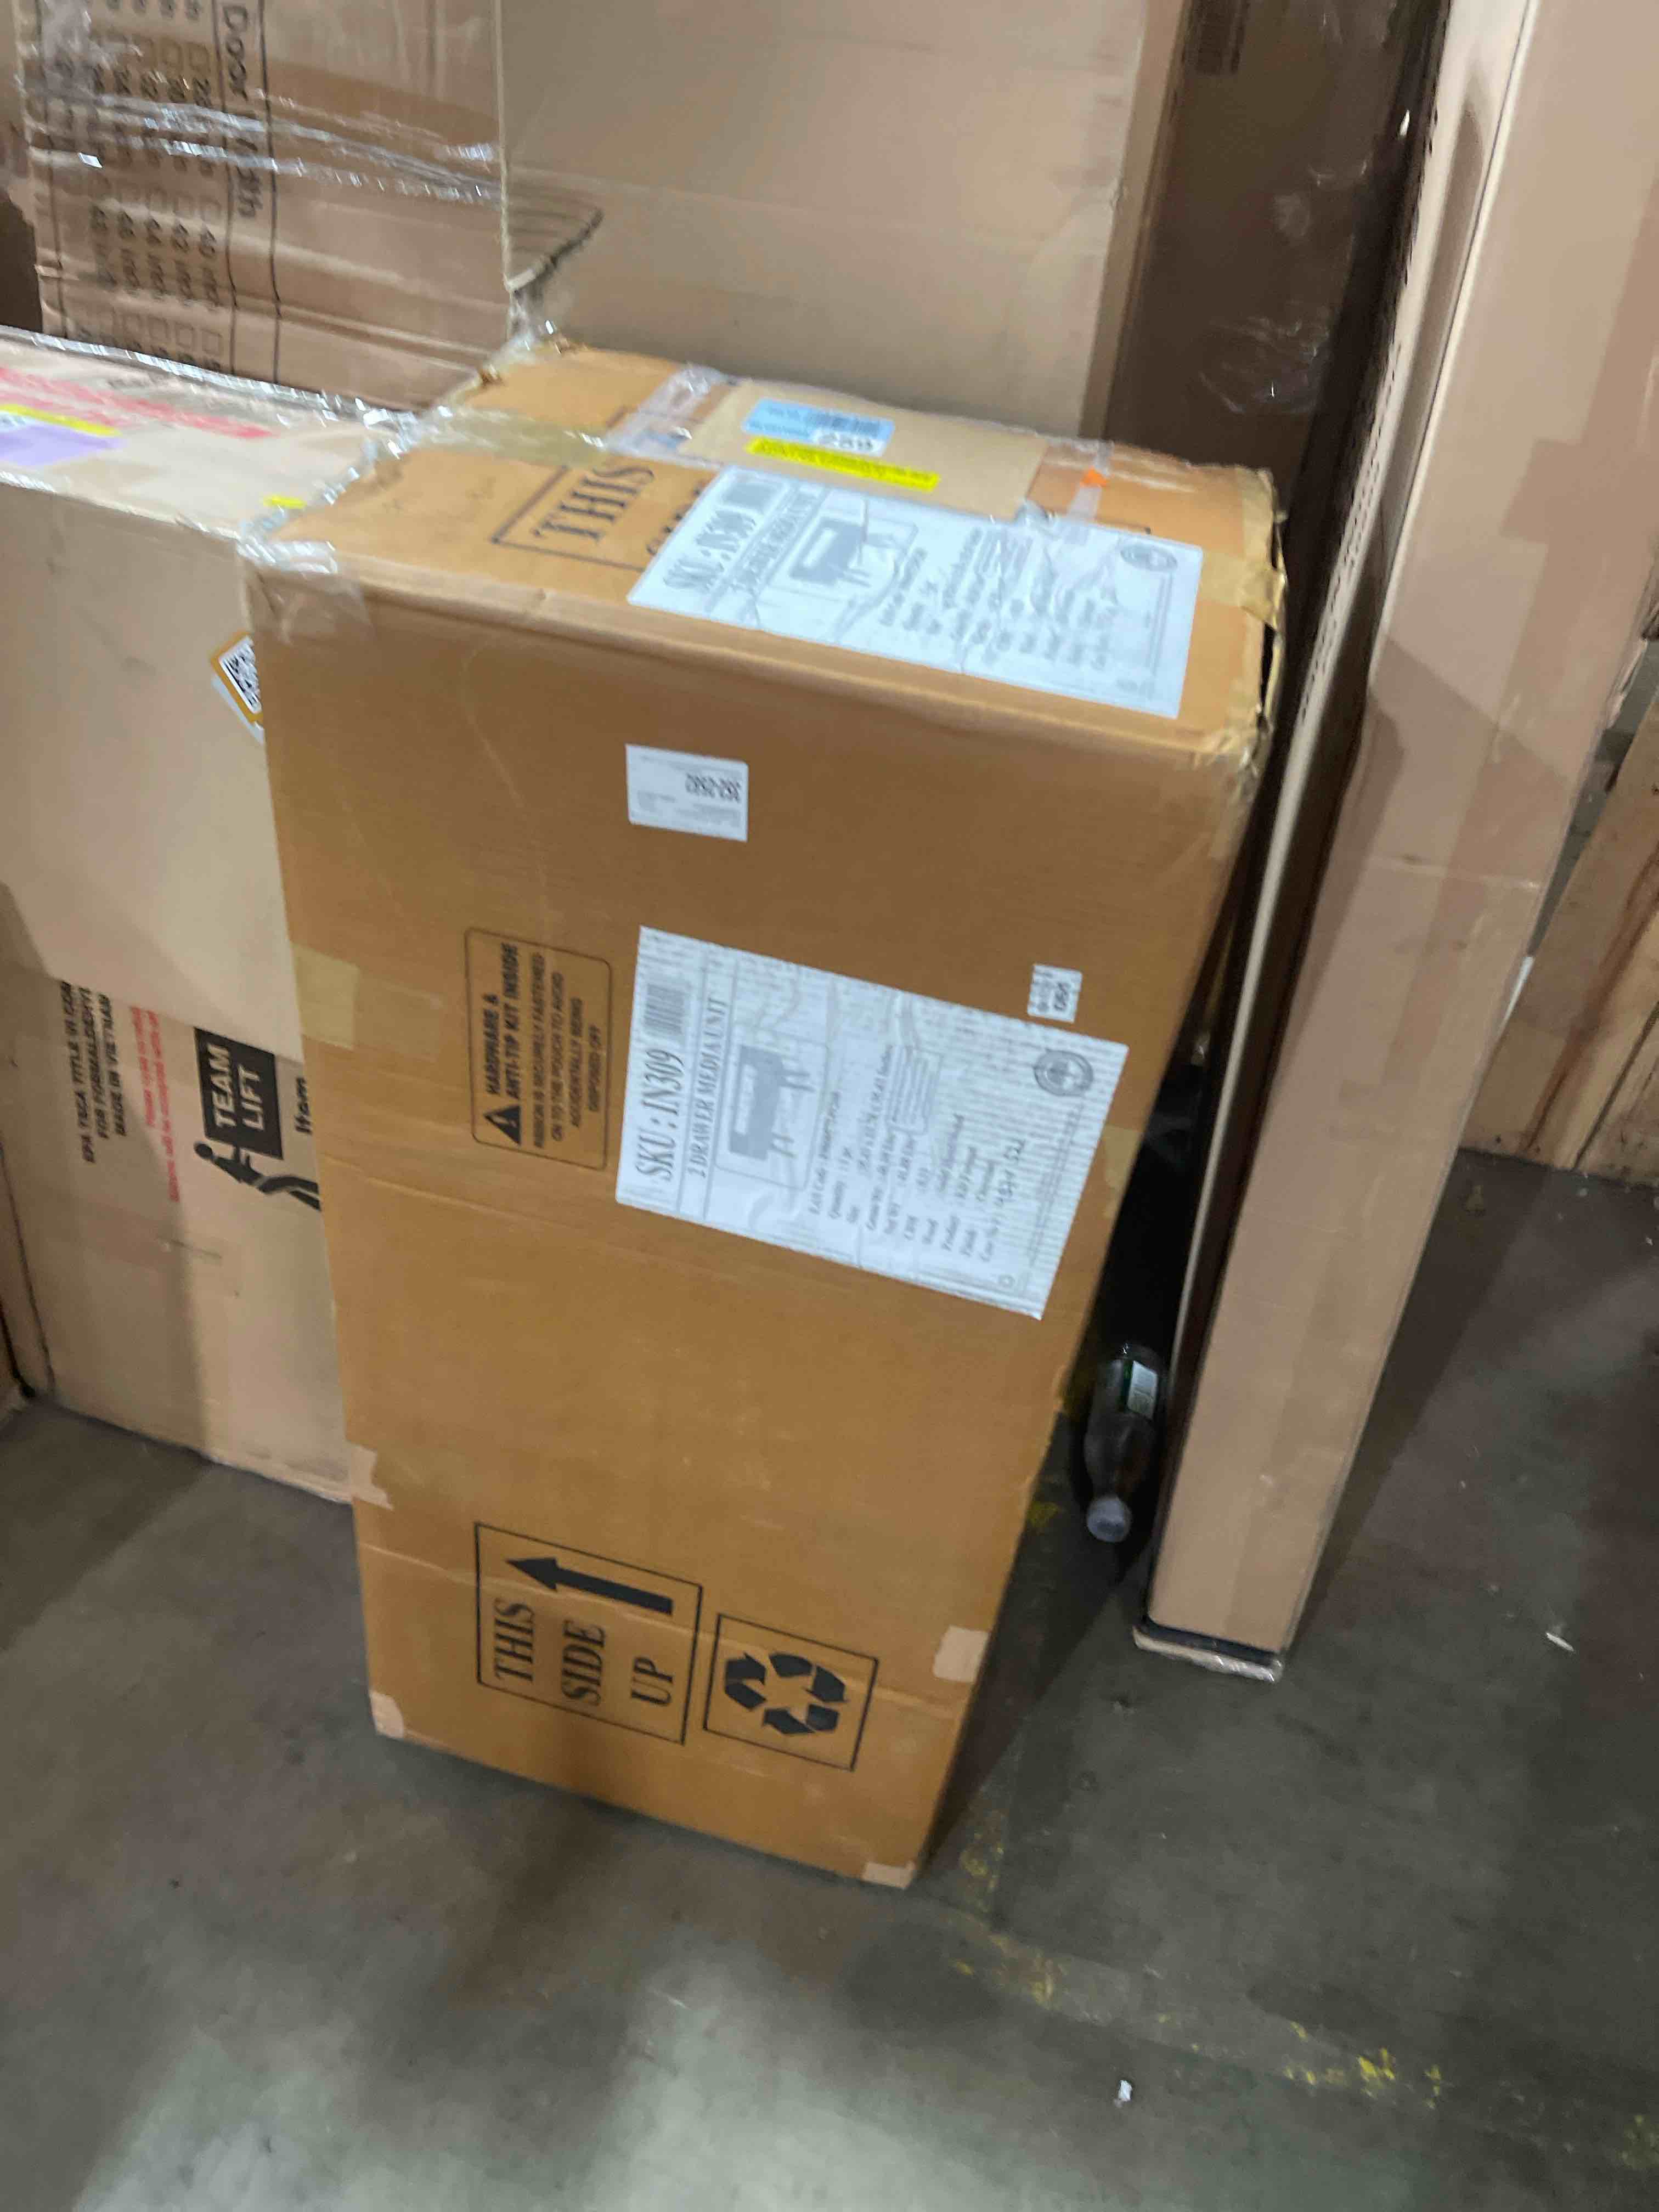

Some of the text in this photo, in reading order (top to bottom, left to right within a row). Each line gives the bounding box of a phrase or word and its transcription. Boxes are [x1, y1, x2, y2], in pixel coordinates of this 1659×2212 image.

[223, 4, 253, 101] Door
[529, 456, 654, 542] THIS
[500, 942, 520, 1099] ANTI-TIP KIT INSIDE
[532, 953, 544, 1023] FASTENED
[551, 971, 562, 1012] AVOID
[705, 996, 727, 1039] UNIT
[69, 1042, 83, 1086] TITLE
[80, 987, 103, 1104] FORMALDEHY
[482, 1008, 500, 1096] HARDWARE
[532, 1023, 545, 1088] SECURELY
[551, 1031, 562, 1078] POUCH
[698, 1041, 720, 1097] MEDIA
[108, 1070, 120, 1088] IN
[207, 1045, 237, 1131] TEAM
[239, 1065, 265, 1131] LIFT
[551, 1080, 562, 1103] THE
[642, 1049, 685, 1117] IN309
[111, 1092, 126, 1137] MADE
[691, 1099, 712, 1166] DRAWER
[635, 1127, 676, 1181] SKU
[493, 1598, 534, 1684] THIS
[560, 1620, 606, 1706] SIDE
[630, 1656, 674, 1707] UP
